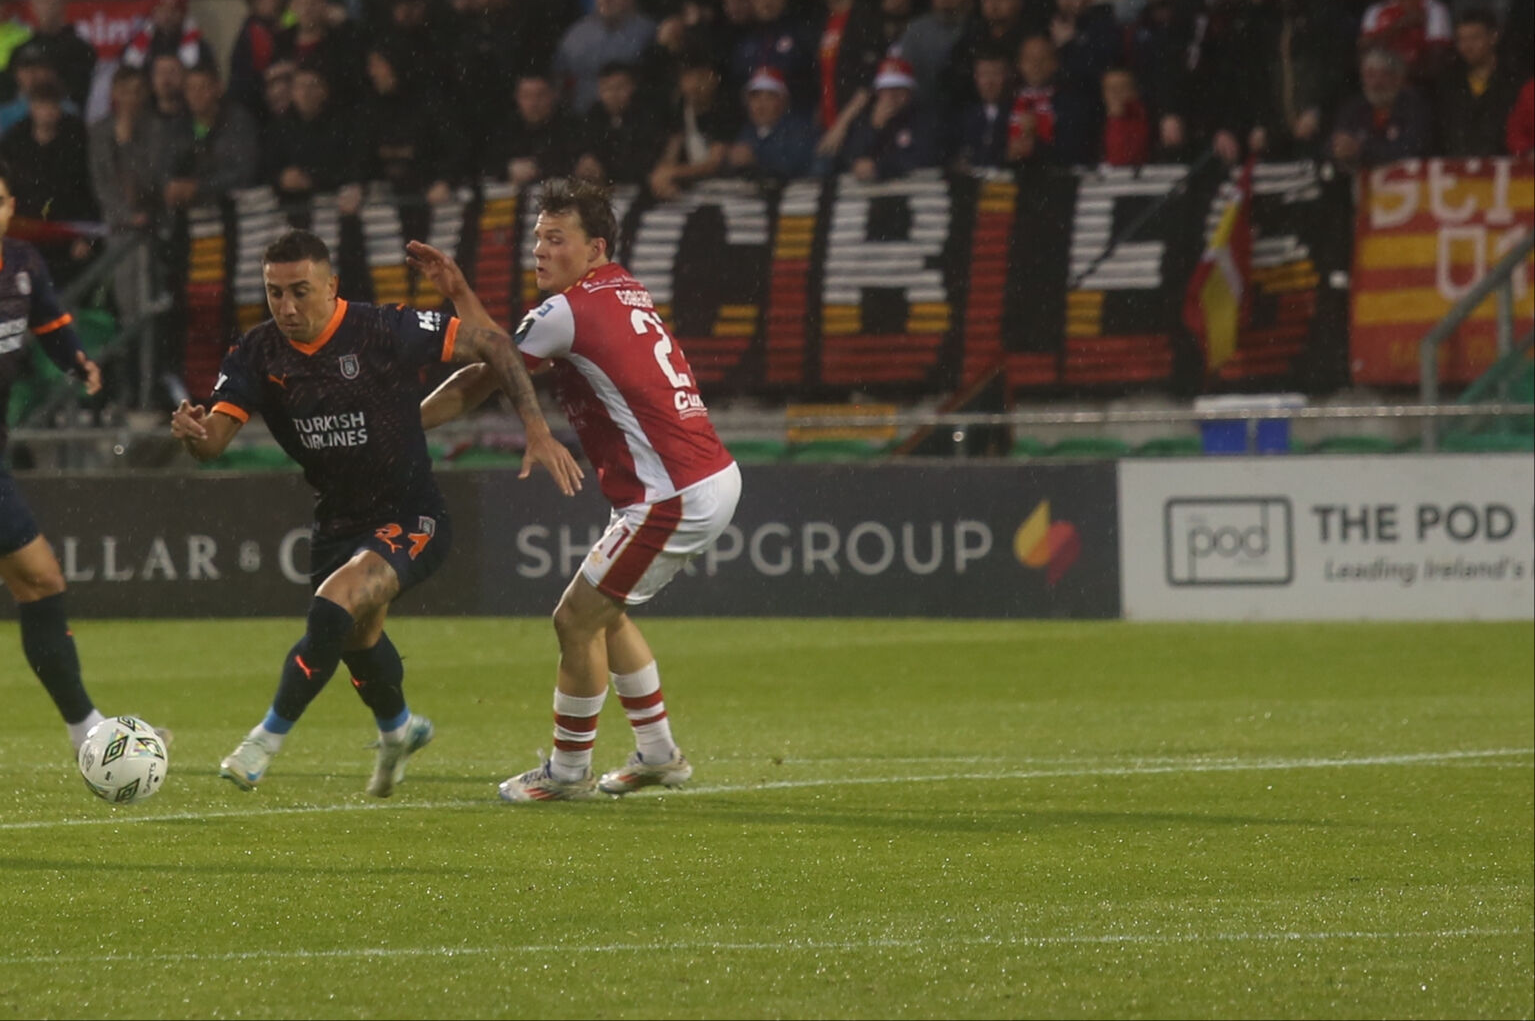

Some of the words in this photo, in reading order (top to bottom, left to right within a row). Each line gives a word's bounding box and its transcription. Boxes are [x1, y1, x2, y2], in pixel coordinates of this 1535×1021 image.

[292, 410, 365, 435] TURKISH
[300, 427, 369, 450] AIRLINES
[1311, 504, 1400, 542] THE
[1415, 503, 1515, 543] POD
[515, 519, 995, 578] SHPGROUP
[1187, 501, 1270, 580] pod
[1324, 557, 1417, 586] Leading
